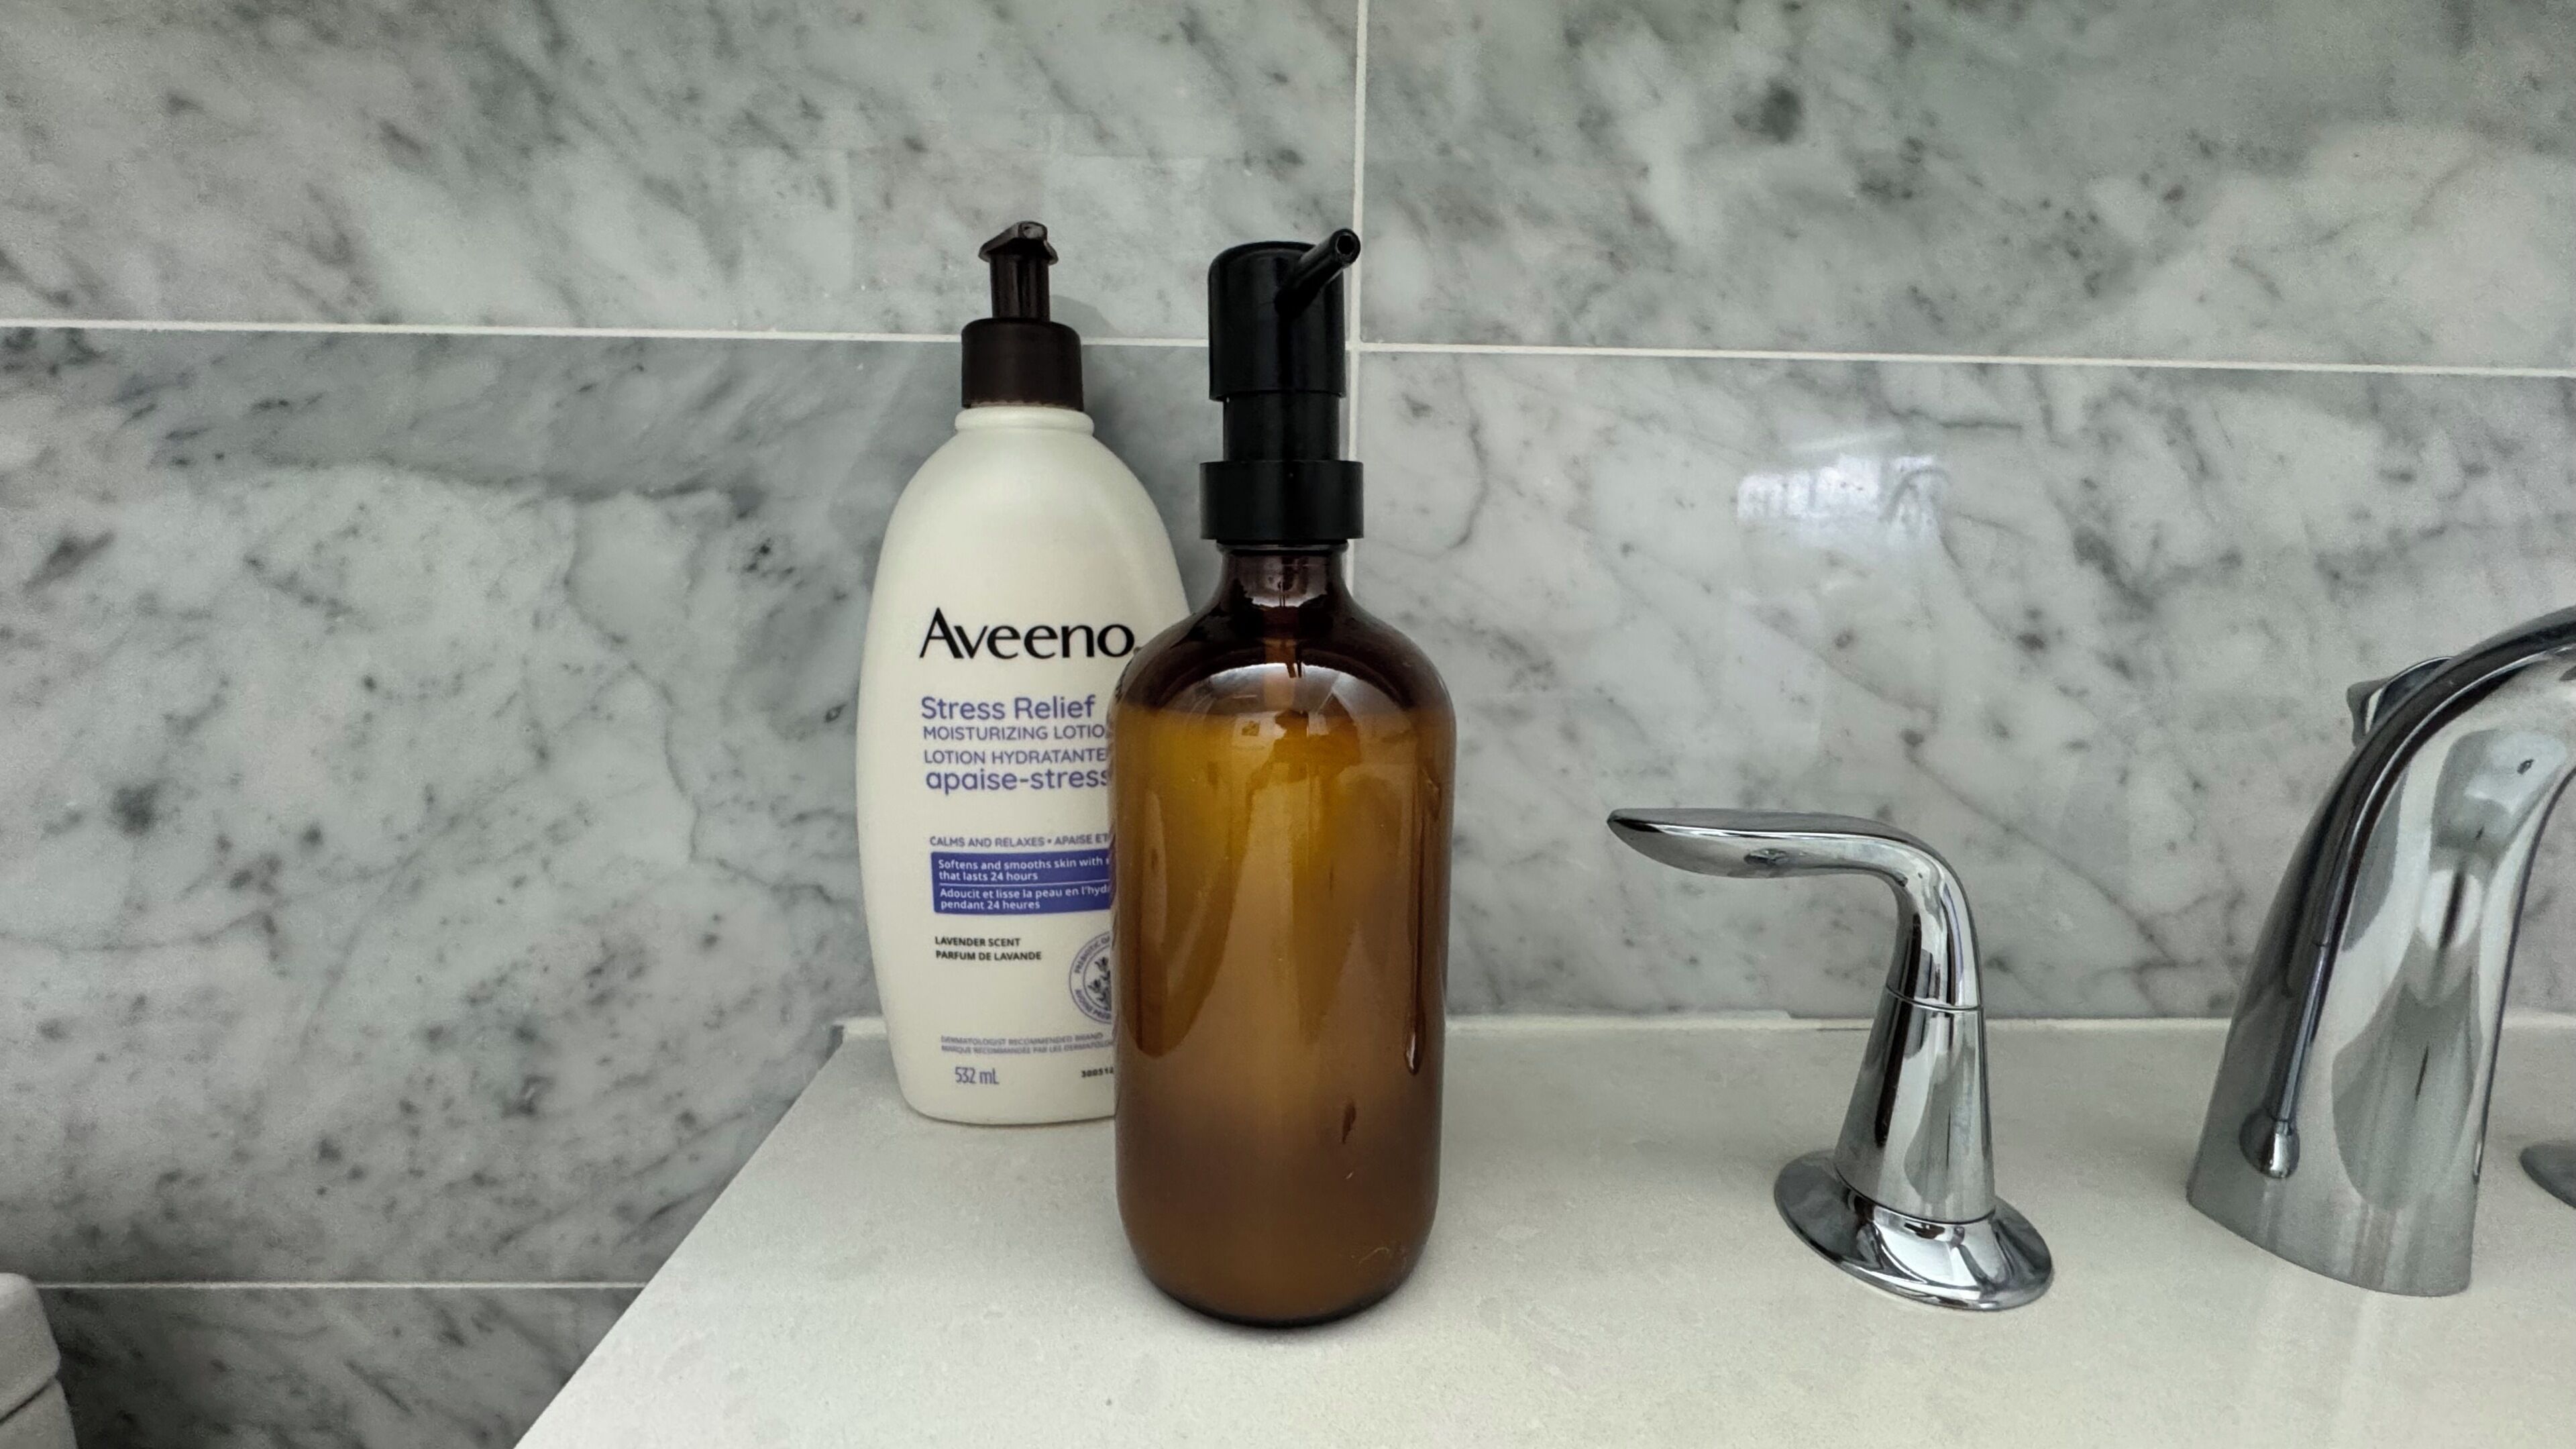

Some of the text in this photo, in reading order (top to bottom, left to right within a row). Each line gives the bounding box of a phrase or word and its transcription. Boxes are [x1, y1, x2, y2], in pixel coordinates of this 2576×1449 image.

[919, 607, 1135, 659] Aveeno
[921, 694, 1096, 720] Stress Relief
[923, 724, 1110, 741] MOISTURIZING LOTIO
[924, 747, 1107, 764] LOTION HYDRATANTE
[930, 836, 966, 847] CALMS
[968, 837, 991, 847] AND
[996, 837, 1045, 847] RELAXES
[1054, 834, 1092, 845] APAISE
[938, 859, 979, 870] Softens
[981, 859, 1001, 870] and
[1004, 857, 1052, 870] smooths
[1054, 857, 1077, 869] skin
[1079, 855, 1103, 867] with
[939, 871, 1038, 881] that lasts 24 hours
[940, 883, 1110, 902] Adoucit et lisse la peau en l'hyd
[941, 900, 1040, 911] pendant 24 heures
[934, 936, 1021, 947] LAVENDER SCENT
[936, 950, 1042, 961] PARFUM DE LAVANDE
[955, 1066, 976, 1083] 532
